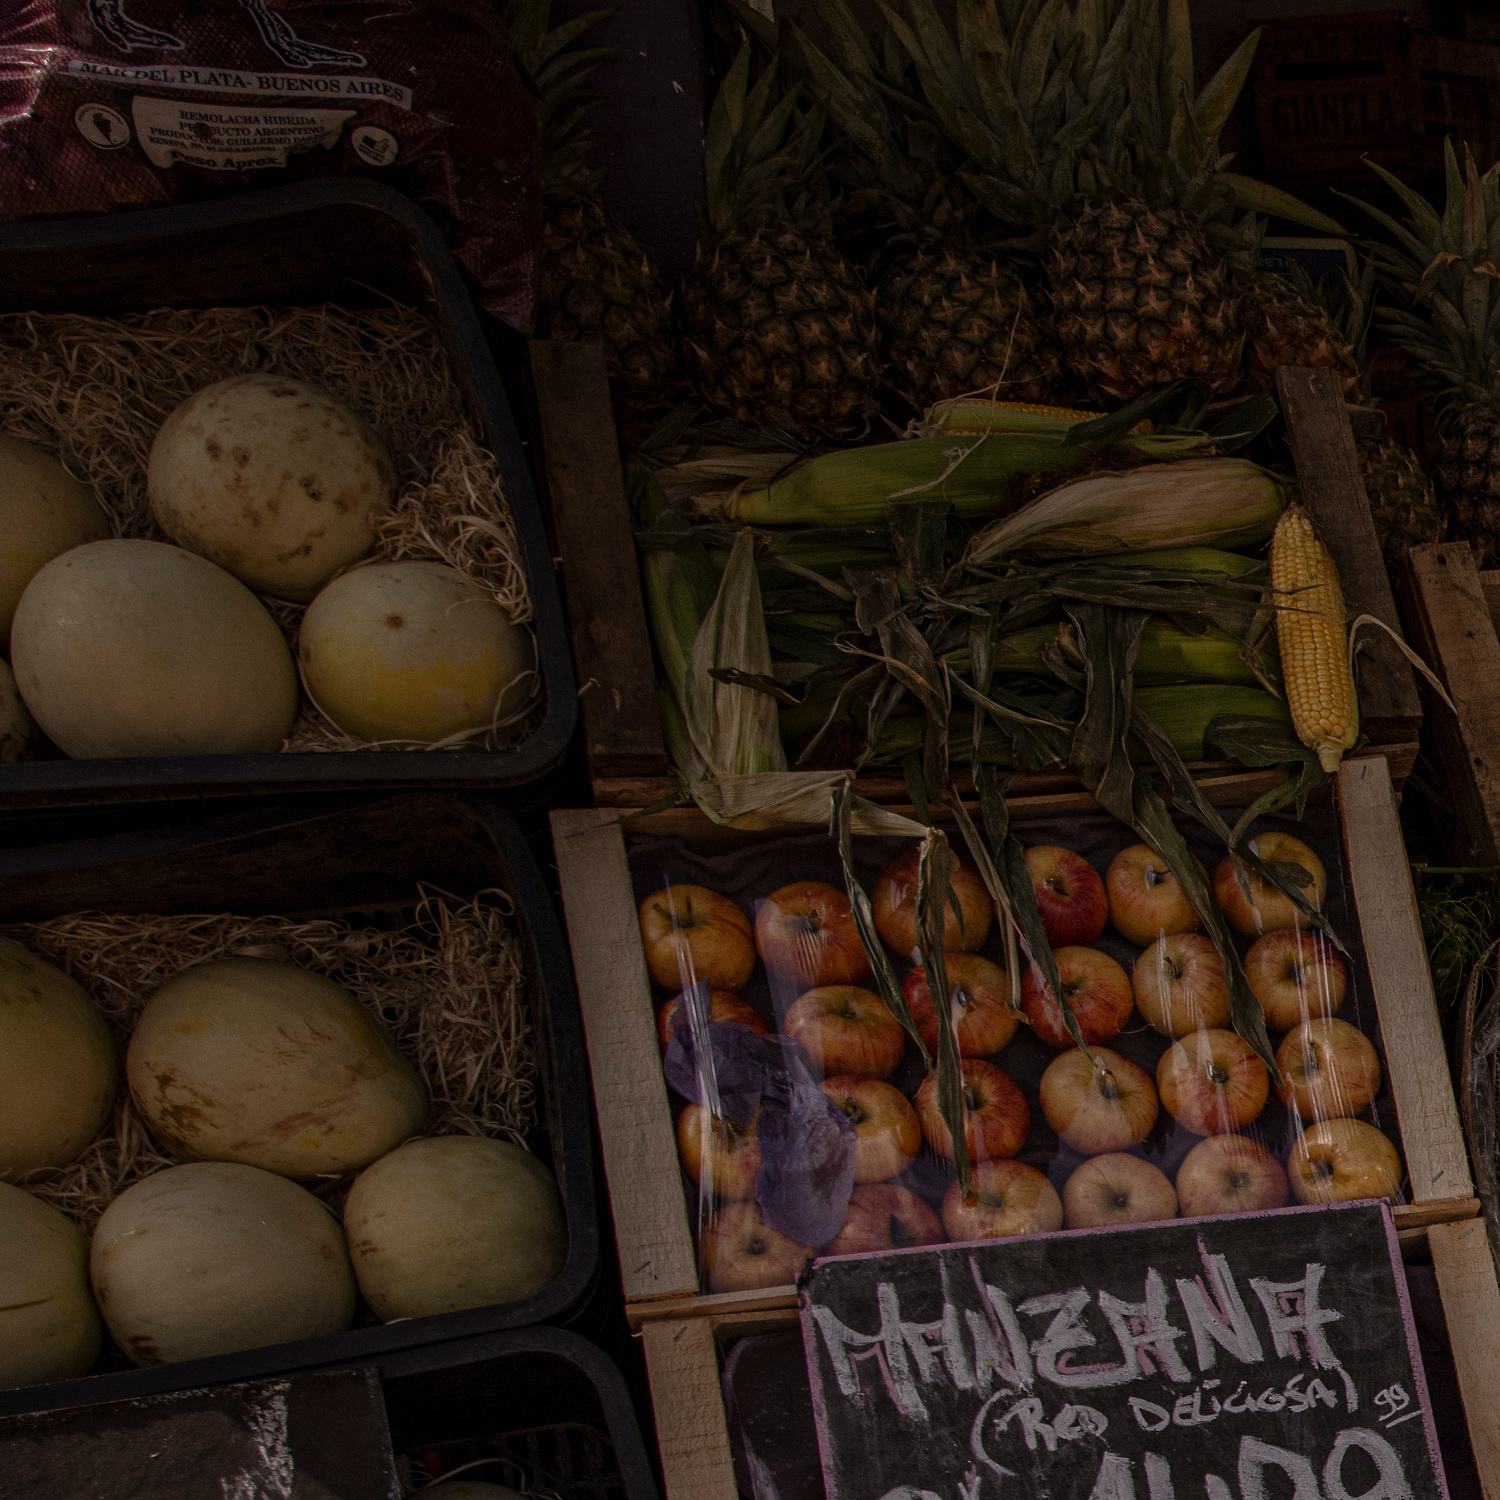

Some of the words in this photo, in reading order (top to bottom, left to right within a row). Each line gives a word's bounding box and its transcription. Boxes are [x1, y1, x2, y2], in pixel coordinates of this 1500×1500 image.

[79, 62, 128, 78] MAR
[132, 69, 175, 82] DEL
[256, 76, 341, 93] BUENOS
[345, 81, 404, 101] AIRES
[179, 110, 261, 125] REMOLACHA
[263, 115, 317, 125] HIBRIDA
[1271, 90, 1397, 138] GIANELA
[179, 122, 251, 137] PRDUCTO
[254, 126, 324, 137] ARGENTINO
[227, 137, 291, 146] GUILLERMO
[171, 150, 217, 166] Peso
[223, 157, 283, 170] Aprox.
[812, 1236, 1345, 1422] MANZANA
